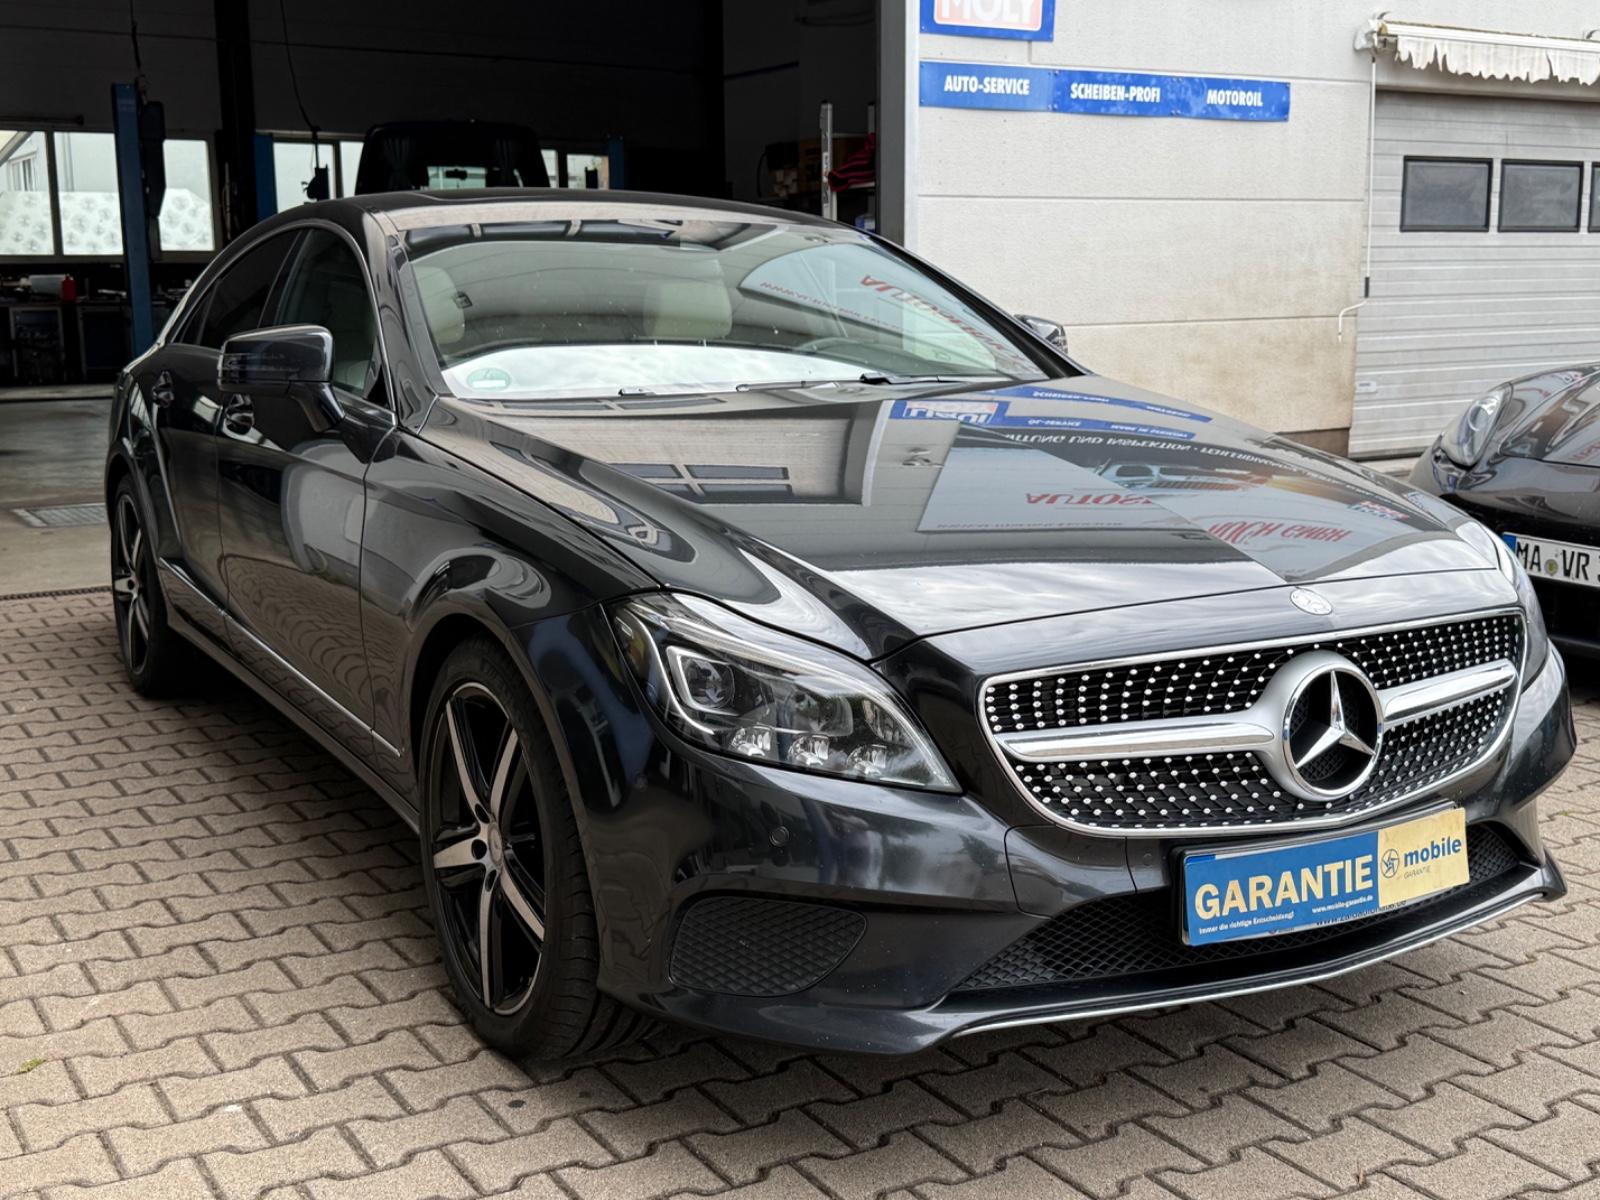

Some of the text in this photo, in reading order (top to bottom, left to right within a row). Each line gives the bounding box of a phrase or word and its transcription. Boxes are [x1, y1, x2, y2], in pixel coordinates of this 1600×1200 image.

[943, 74, 1030, 96] AUTO-SERVICE
[1070, 82, 1161, 103] SCHEIBEN-PROFI
[1206, 89, 1263, 107] MOTOROIL
[1516, 541, 1541, 572] MA
[1562, 549, 1590, 581] VR
[1404, 836, 1462, 868] mobile
[1195, 854, 1373, 921] GARANTIE
[1199, 925, 1219, 935] Immer
[1219, 922, 1229, 931] die
[1229, 919, 1252, 929] richtige
